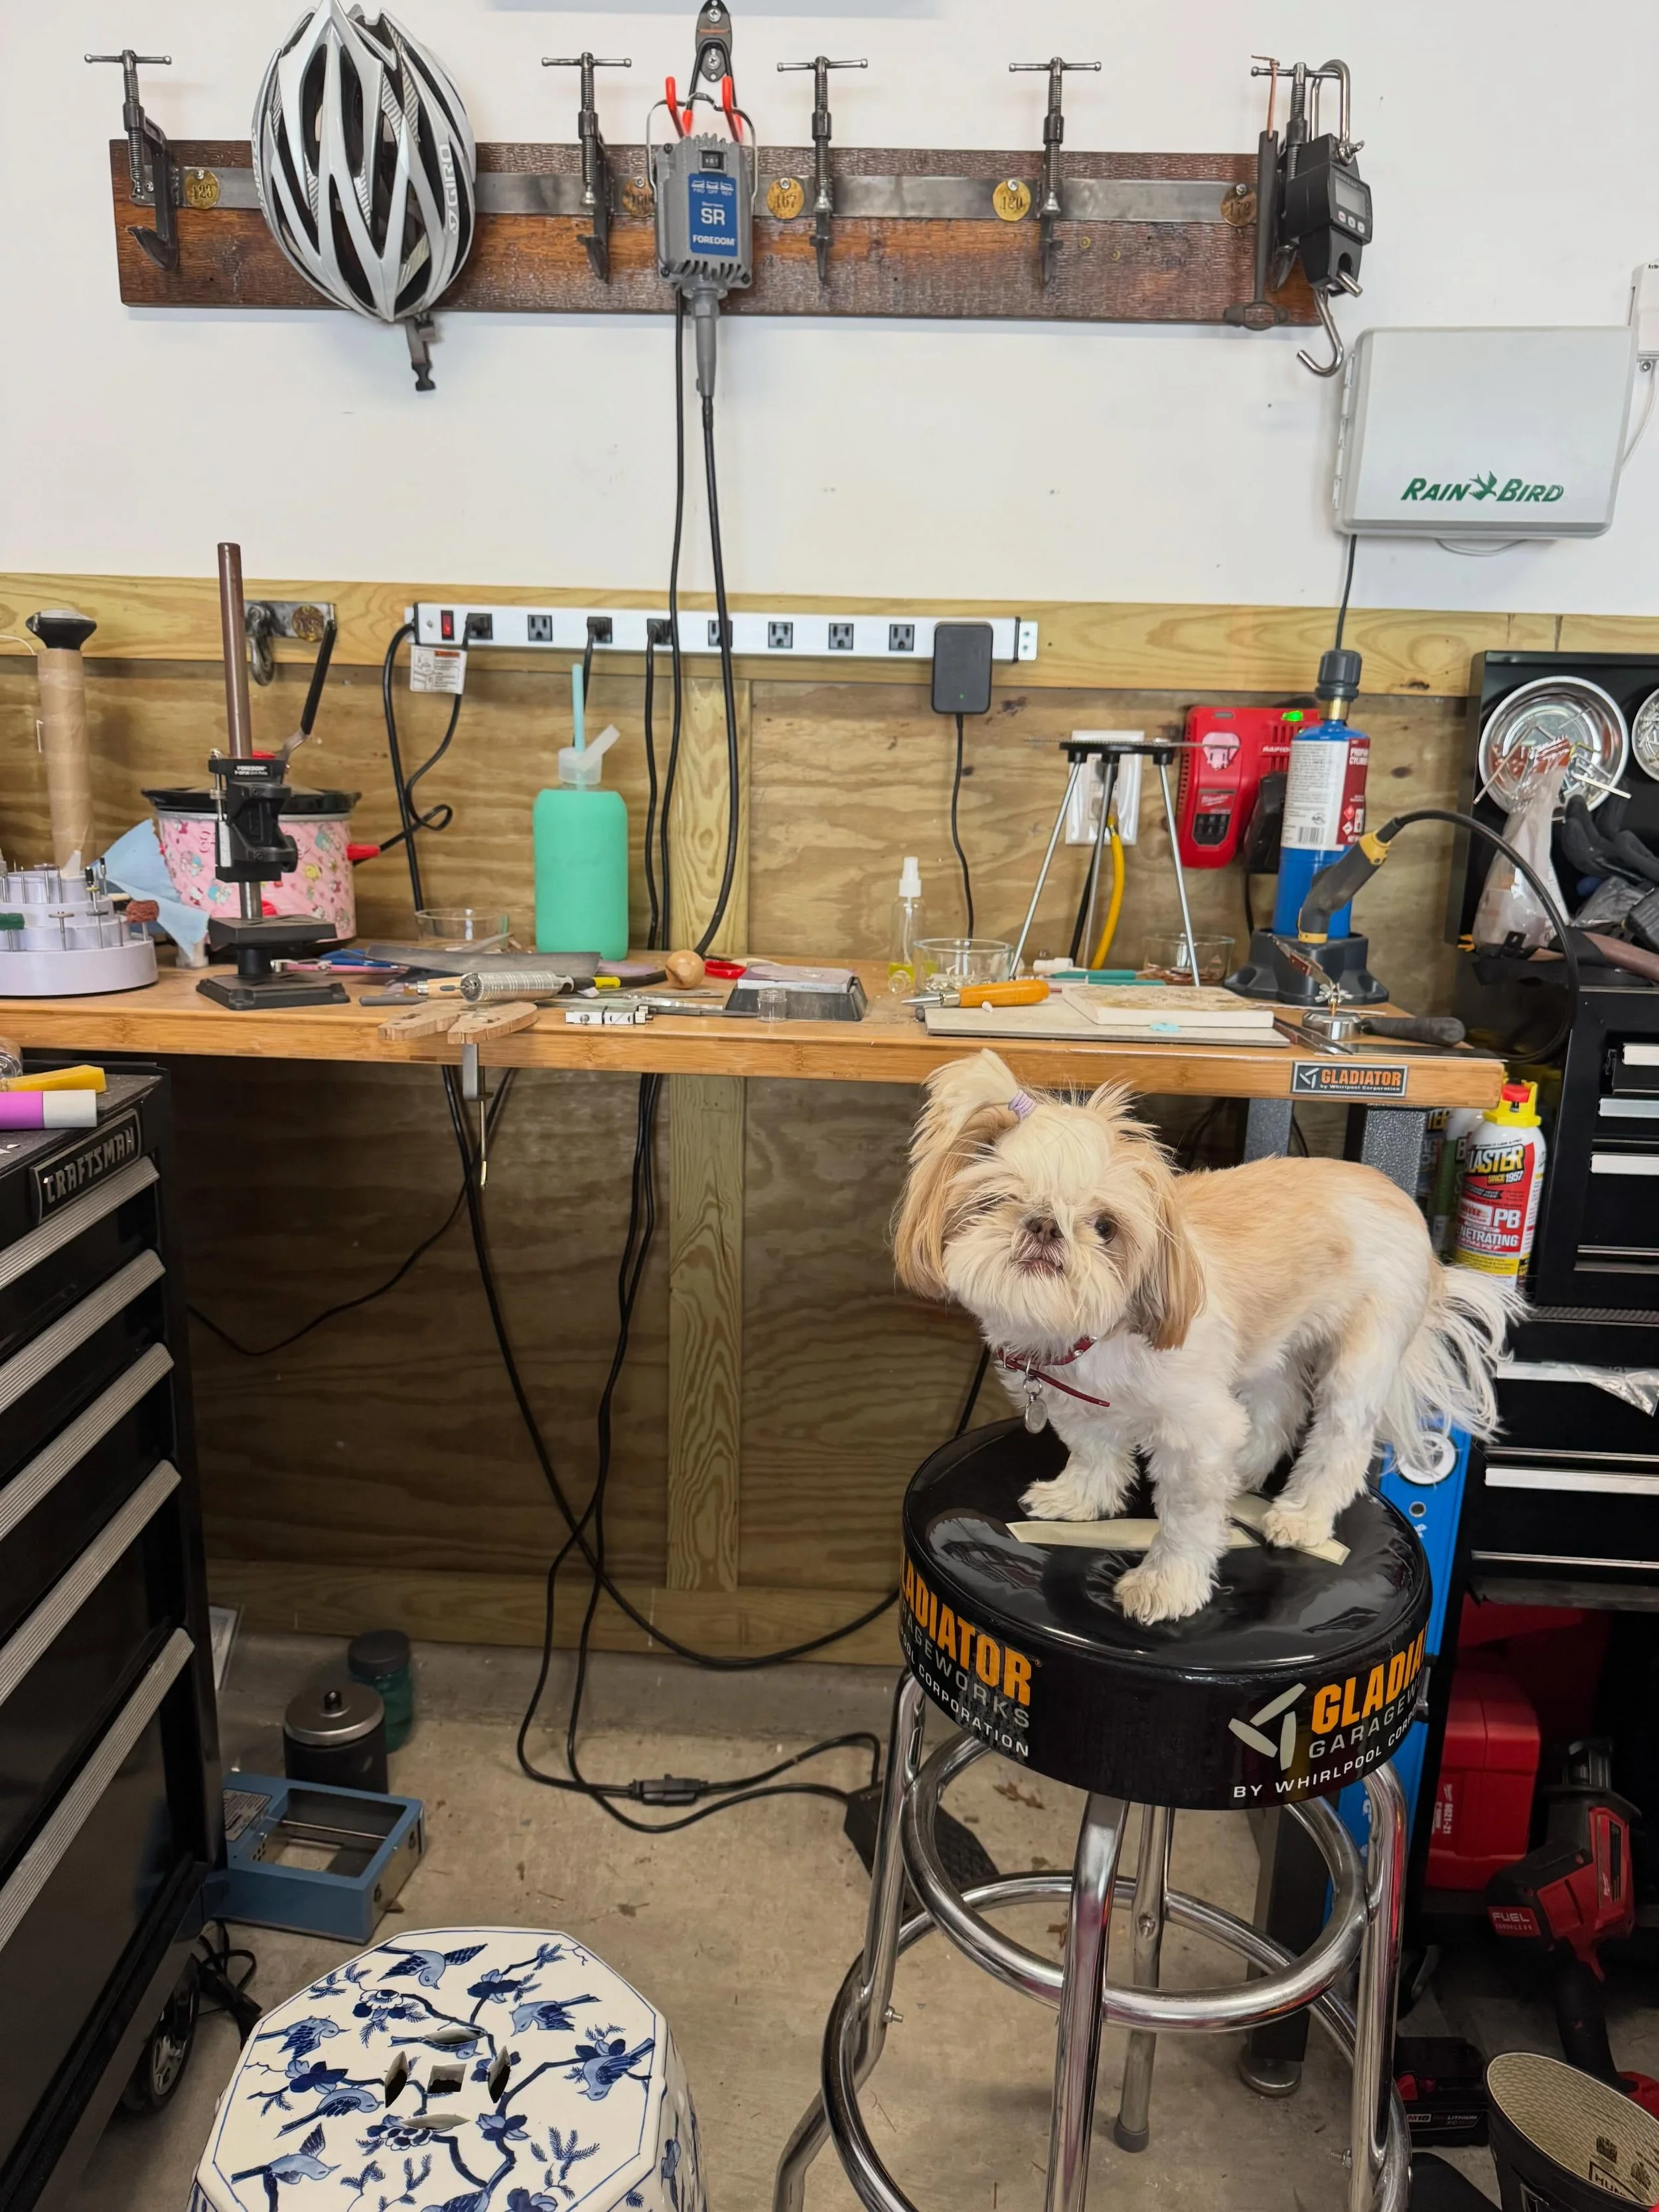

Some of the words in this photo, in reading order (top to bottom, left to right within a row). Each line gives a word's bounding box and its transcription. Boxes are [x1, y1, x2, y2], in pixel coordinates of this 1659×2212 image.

[439, 143, 458, 207] GIRO
[701, 208, 726, 226] SR
[692, 234, 735, 246] FOREDOM
[1400, 477, 1472, 501] RAIN
[1495, 479, 1564, 502] BIRD
[1321, 1069, 1402, 1086] GLADIATOR
[43, 1127, 135, 1204] CRAFTSMAN
[1465, 1145, 1524, 1173] LASTER
[1492, 1208, 1522, 1228] PB
[1459, 1225, 1519, 1246] NETRATING
[1311, 1620, 1427, 1735] GLADIA
[918, 1663, 1029, 1757] CORPORATION
[1234, 1784, 1263, 1798] BY
[1275, 1745, 1382, 1793] WHIRLPOOL
[1492, 1912, 1530, 1923] FUEL
